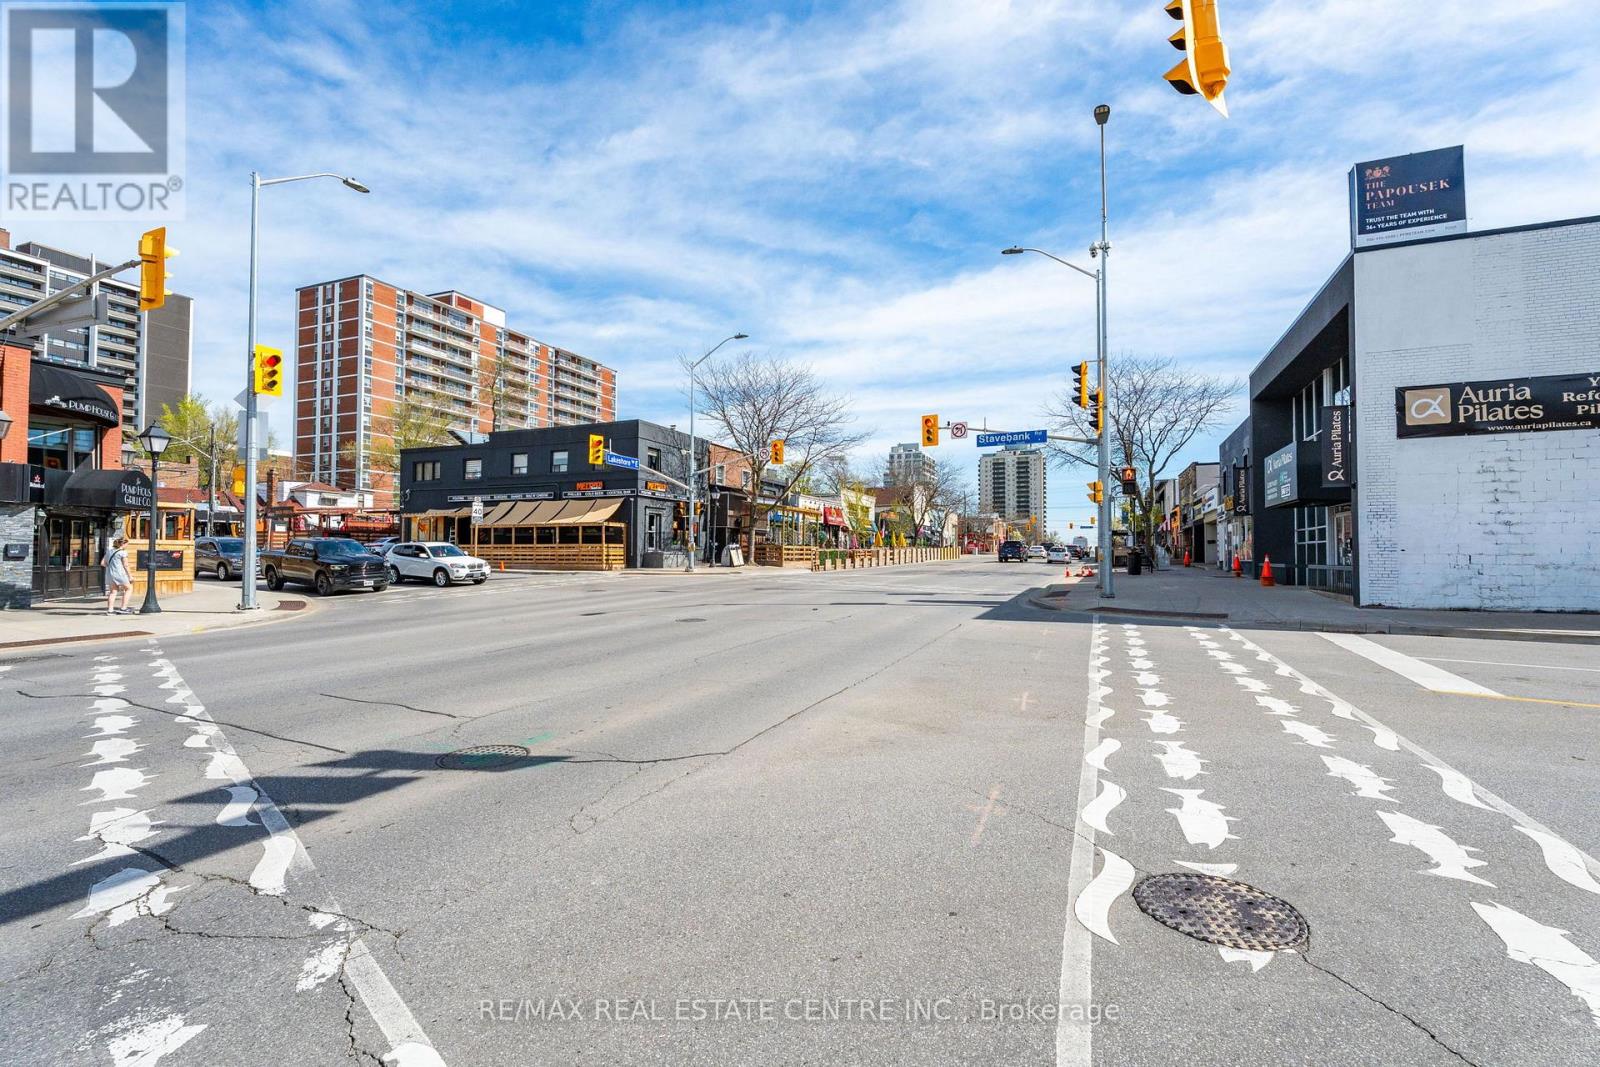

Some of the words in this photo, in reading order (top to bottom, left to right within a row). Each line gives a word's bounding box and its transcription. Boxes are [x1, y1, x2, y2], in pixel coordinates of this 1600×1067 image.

[1366, 181, 1386, 190] THE
[1366, 179, 1451, 201] PAPOUSEK
[1367, 200, 1395, 210] TEAM
[1418, 208, 1435, 216] WITH
[1377, 220, 1398, 228] YEARS
[1408, 213, 1448, 225] EXPERIENCE
[1458, 383, 1531, 404] Auria
[1458, 403, 1544, 423] Pilates
[1331, 410, 1342, 440] Pilates
[1487, 420, 1592, 432] www.auriapilates.ca
[978, 431, 1031, 444] Stavebank
[1331, 441, 1342, 468] Auria
[137, 486, 152, 497] HOUS
[124, 493, 141, 506] GRILLE
[473, 508, 482, 516] 40
